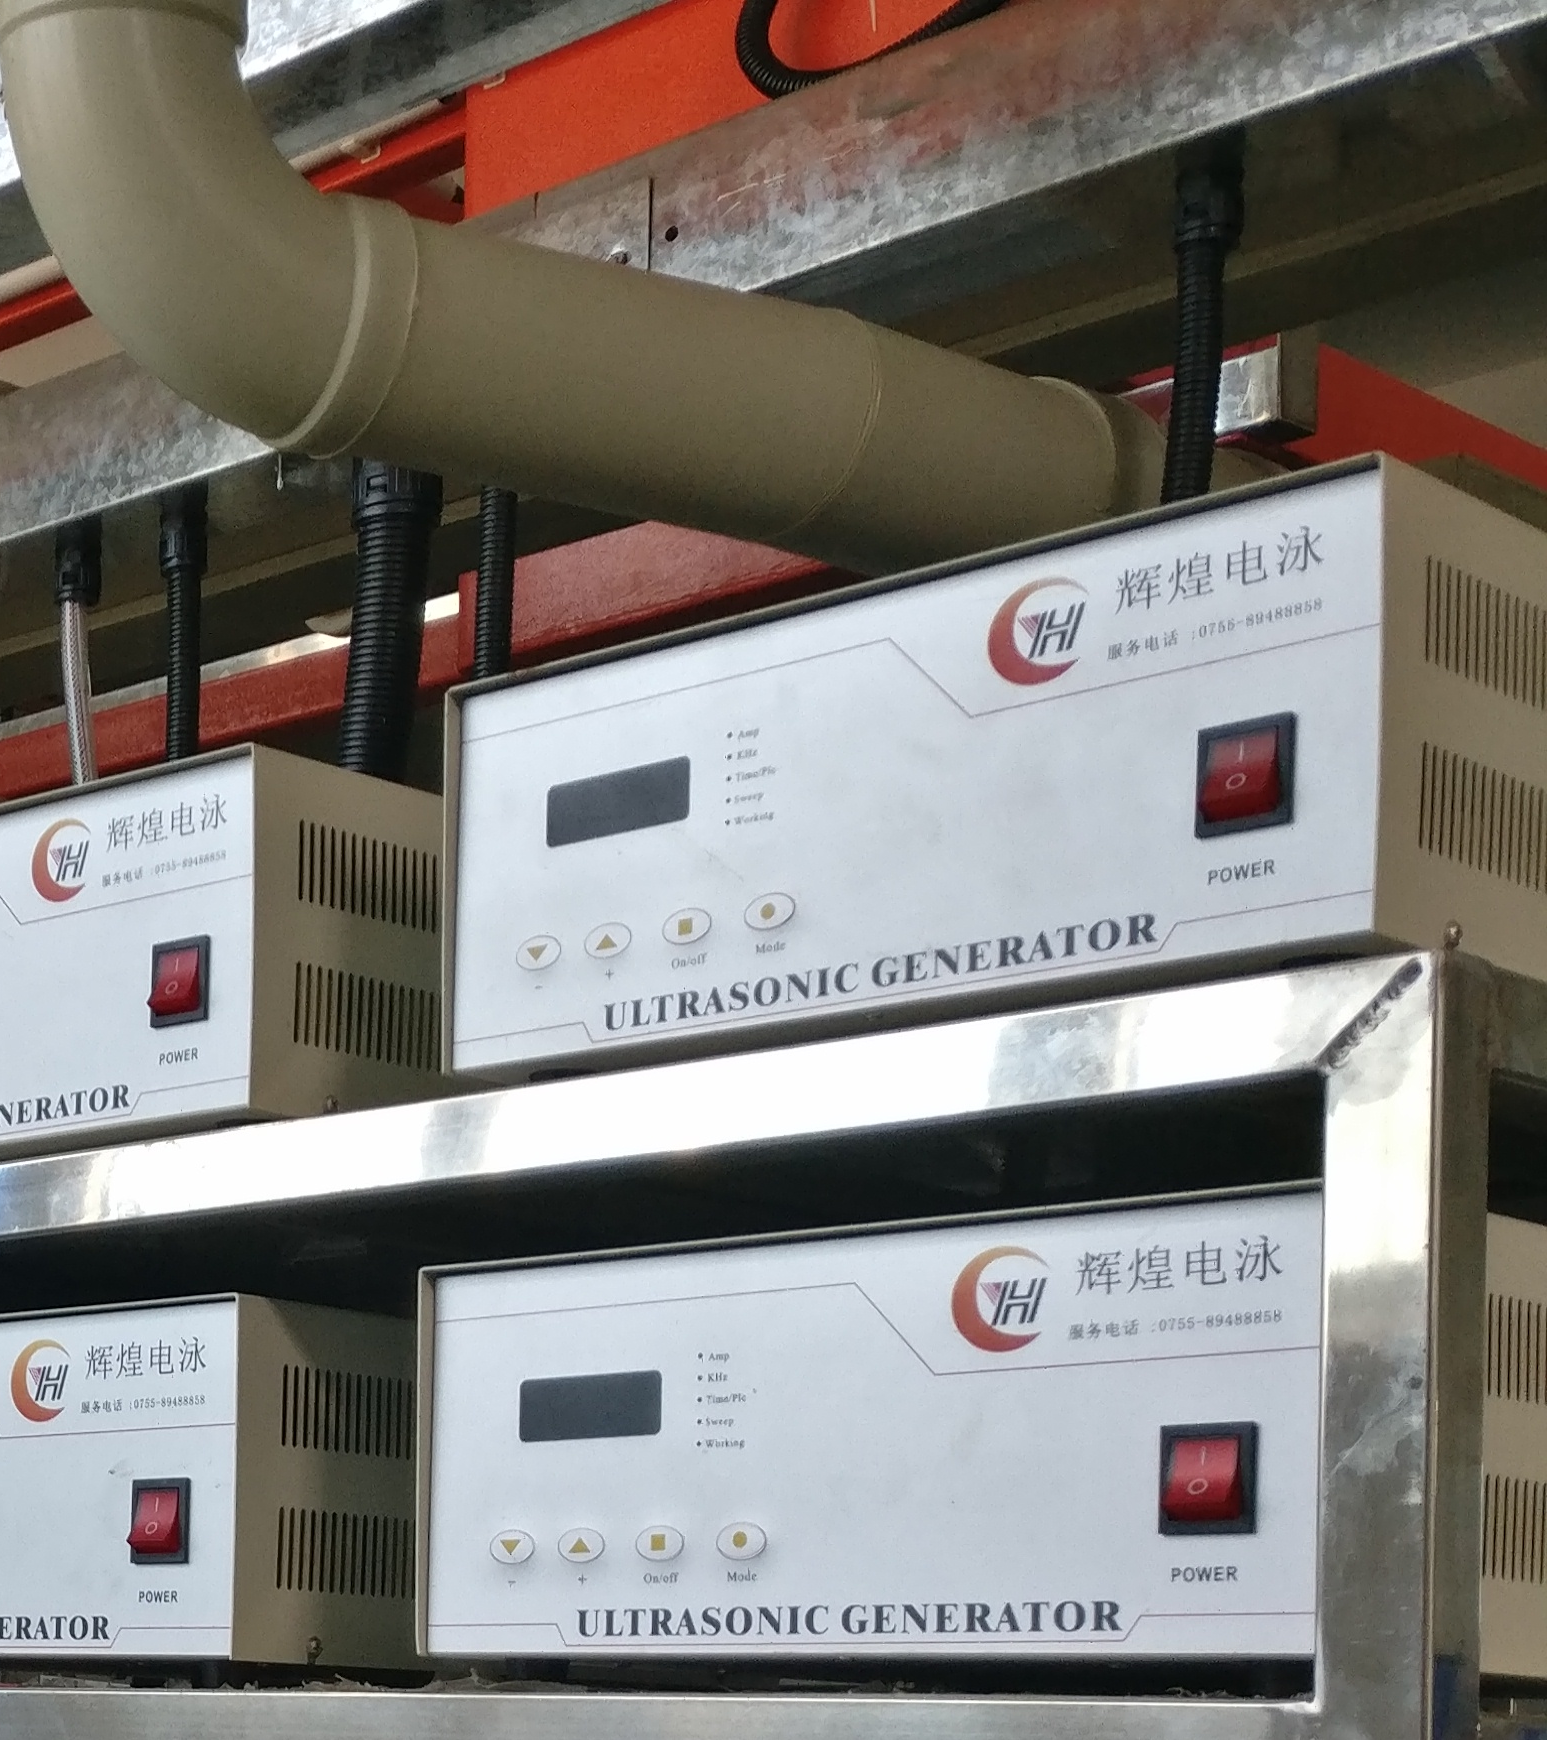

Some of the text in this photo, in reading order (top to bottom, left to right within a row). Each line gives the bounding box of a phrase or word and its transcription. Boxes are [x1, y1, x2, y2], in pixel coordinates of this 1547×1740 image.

[1114, 522, 1325, 615] 辉煌电泳
[1107, 628, 1178, 660] 服务电话
[106, 792, 228, 852] 辉煌电泳
[1208, 860, 1276, 885] POWER
[755, 938, 786, 955] Mode
[671, 952, 707, 969] On/off
[603, 912, 1157, 1032] ULTRASONIC GENERATOR
[159, 1048, 198, 1065] POWER
[1076, 1234, 1283, 1295] 辉煌电泳
[1068, 1318, 1138, 1340] 服务电话
[84, 1336, 207, 1380] 辉煌电泳
[709, 1352, 729, 1363] Amp
[708, 1372, 728, 1382] KHz
[706, 1438, 745, 1449] Working
[644, 1572, 679, 1583] On/off
[727, 1569, 757, 1582] Mode
[1171, 1567, 1238, 1582] POWER
[138, 1591, 178, 1603] POWER
[576, 1600, 1122, 1637] ULTRASONIC GENERATOR
